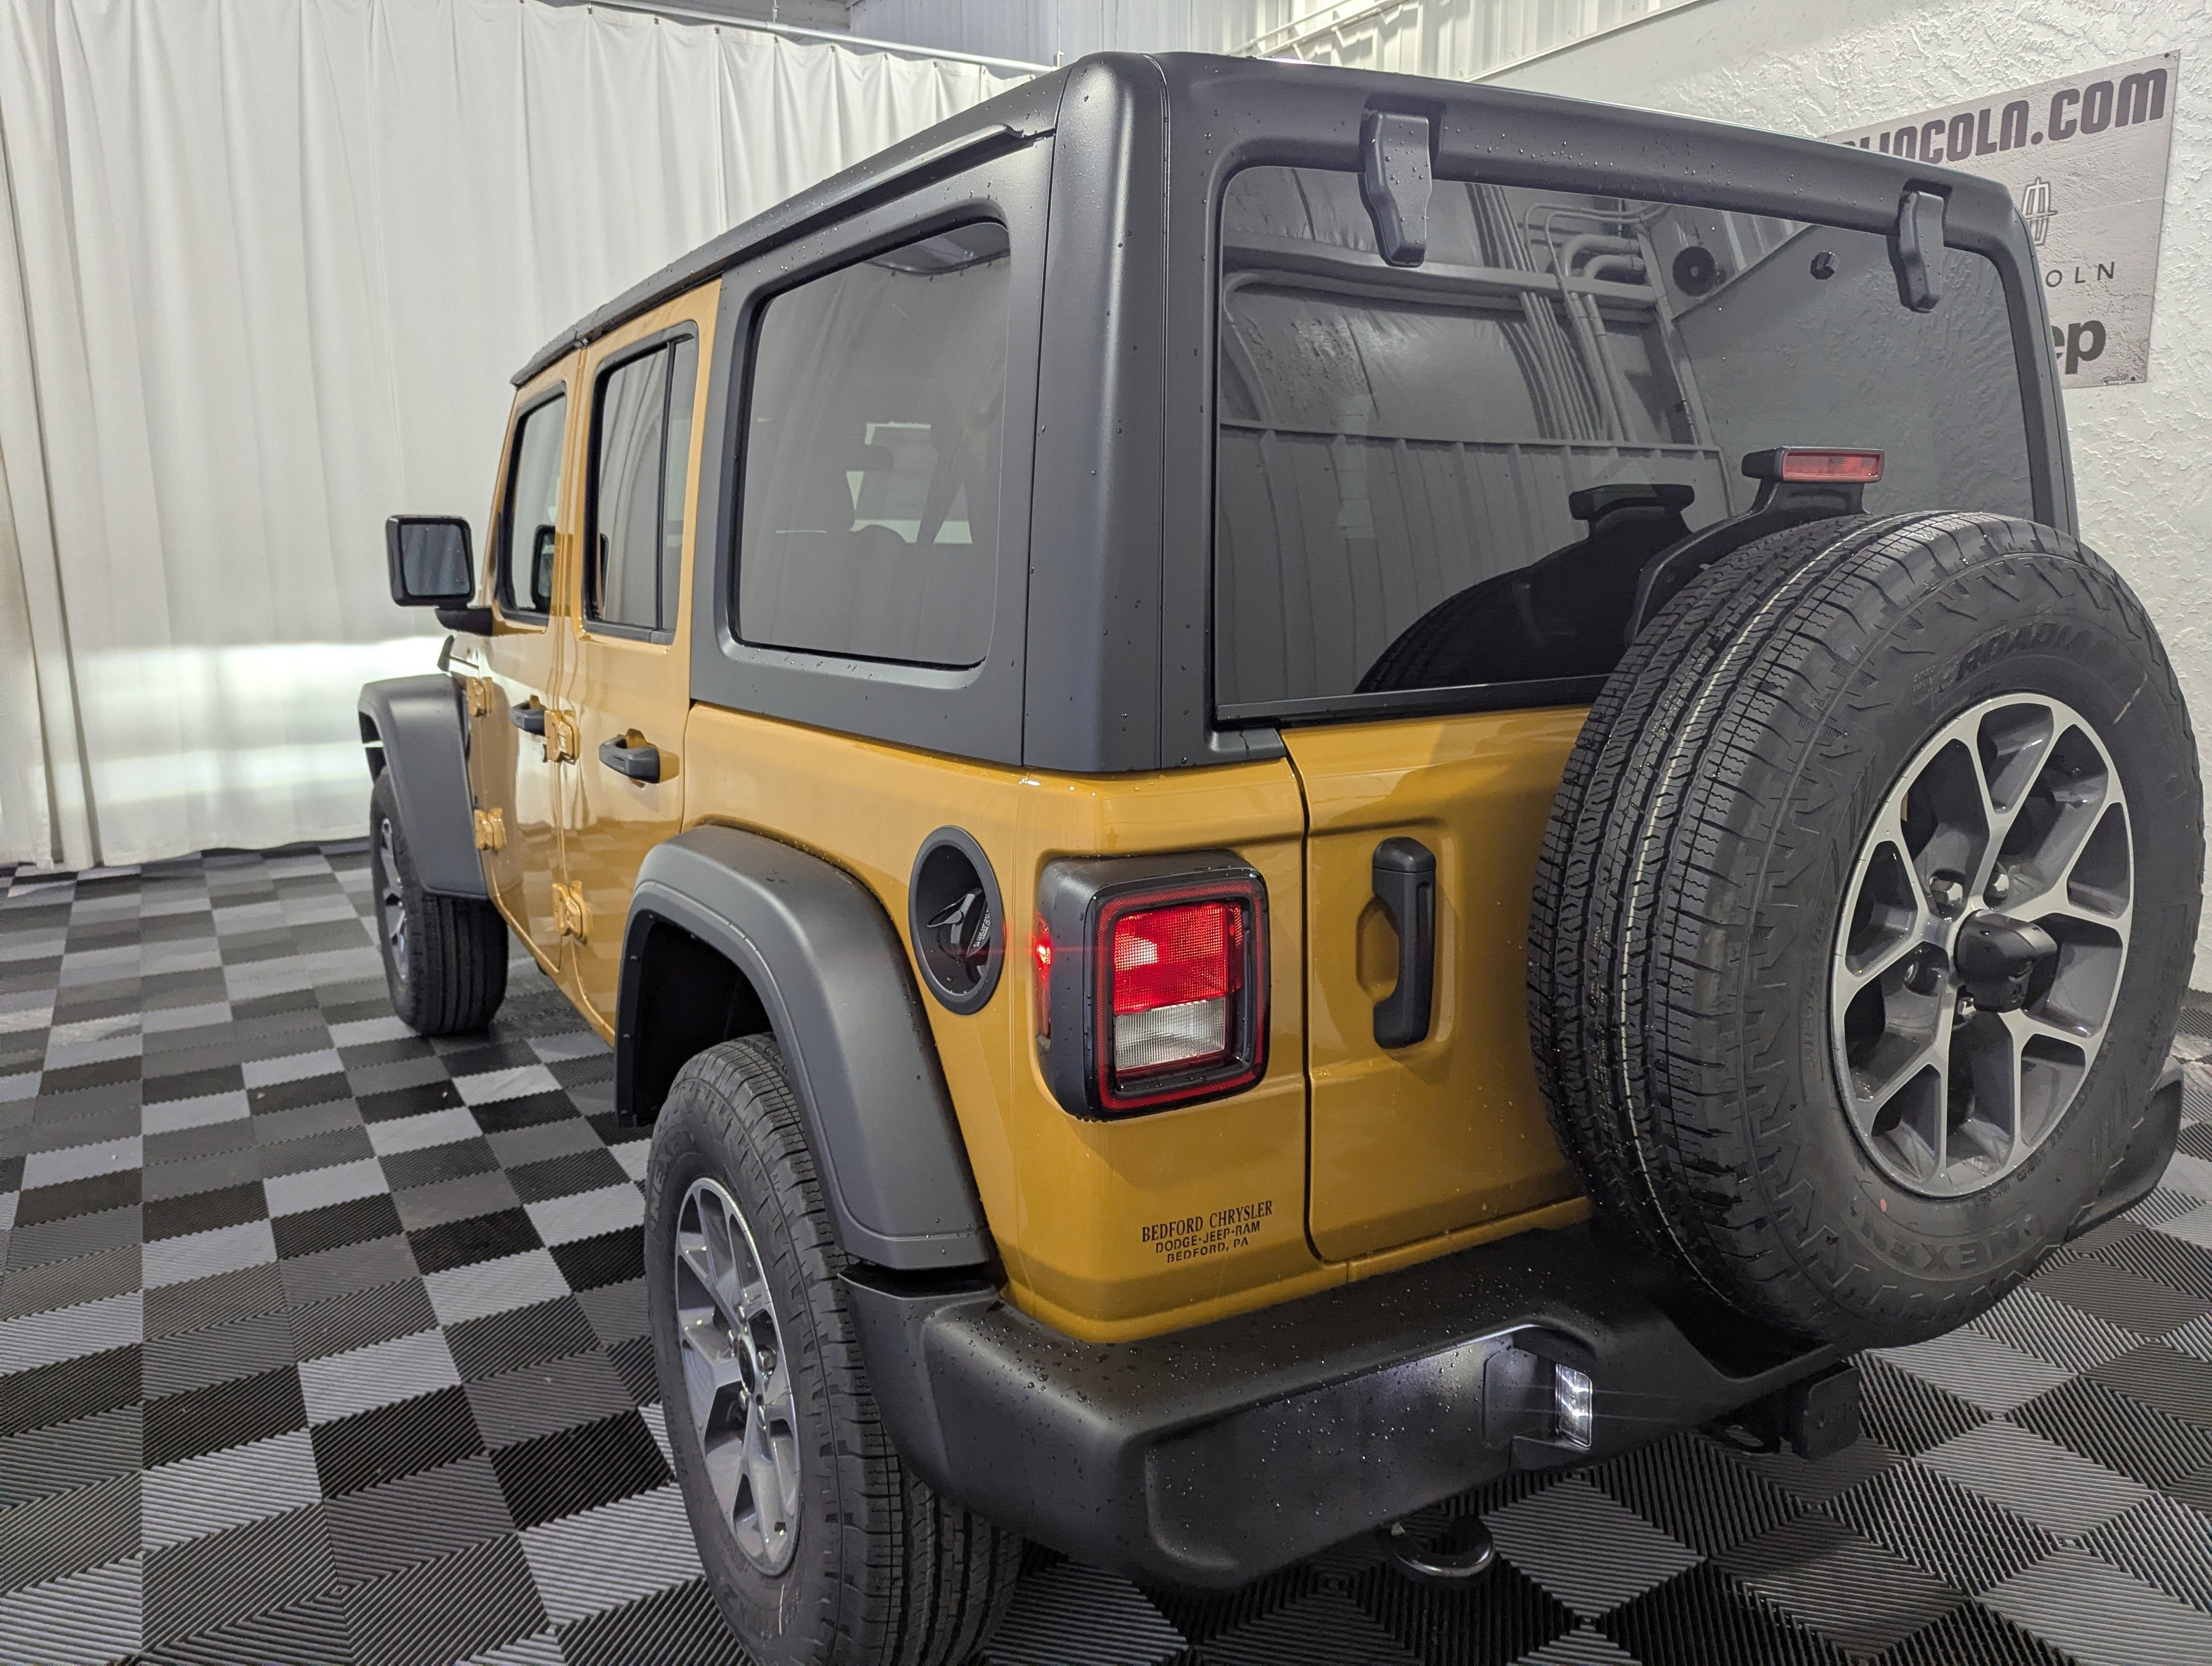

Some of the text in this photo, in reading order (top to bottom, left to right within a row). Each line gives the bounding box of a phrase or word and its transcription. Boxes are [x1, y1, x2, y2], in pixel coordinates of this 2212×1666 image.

[1141, 1200, 1273, 1242] BEDFORD CHRYSLER
[1860, 1209, 2021, 1272] NEXEN
[1167, 1236, 1249, 1263] BEDFORD, PA
